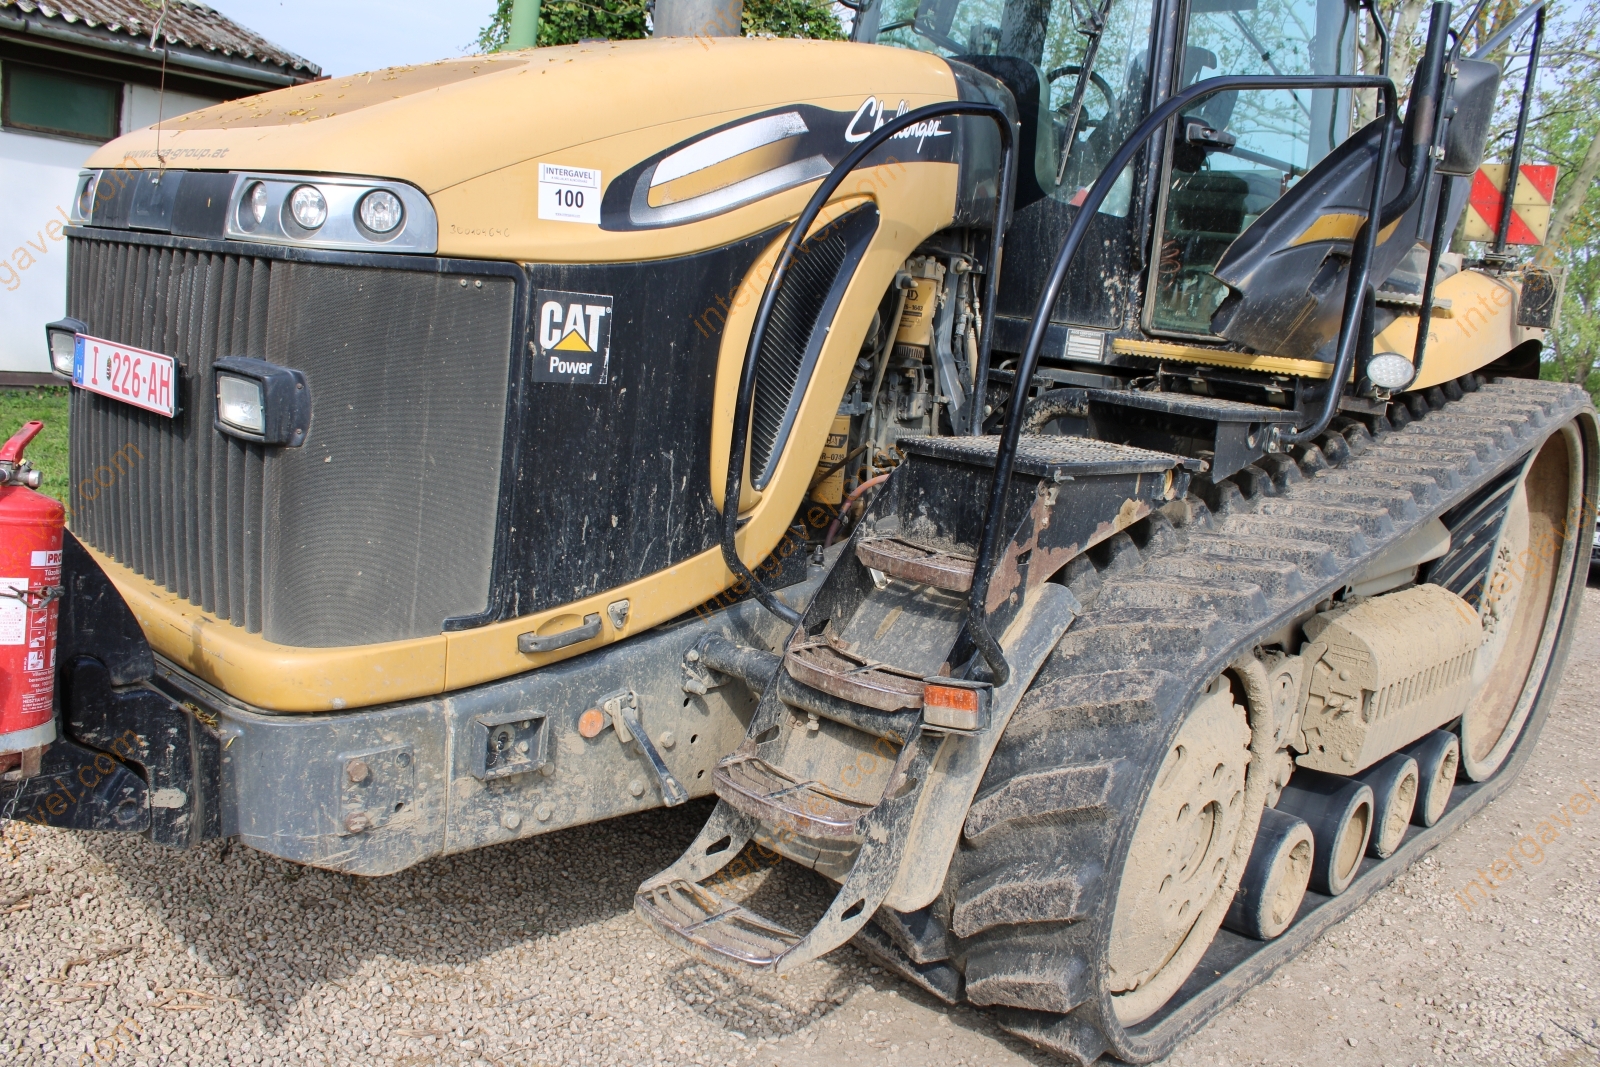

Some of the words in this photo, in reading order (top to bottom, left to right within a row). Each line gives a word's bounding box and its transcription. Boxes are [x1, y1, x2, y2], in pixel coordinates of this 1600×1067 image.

[546, 167, 593, 179] INTERGAVEL
[555, 188, 584, 208] 100
[539, 300, 606, 353] CAT
[549, 356, 593, 375] Power
